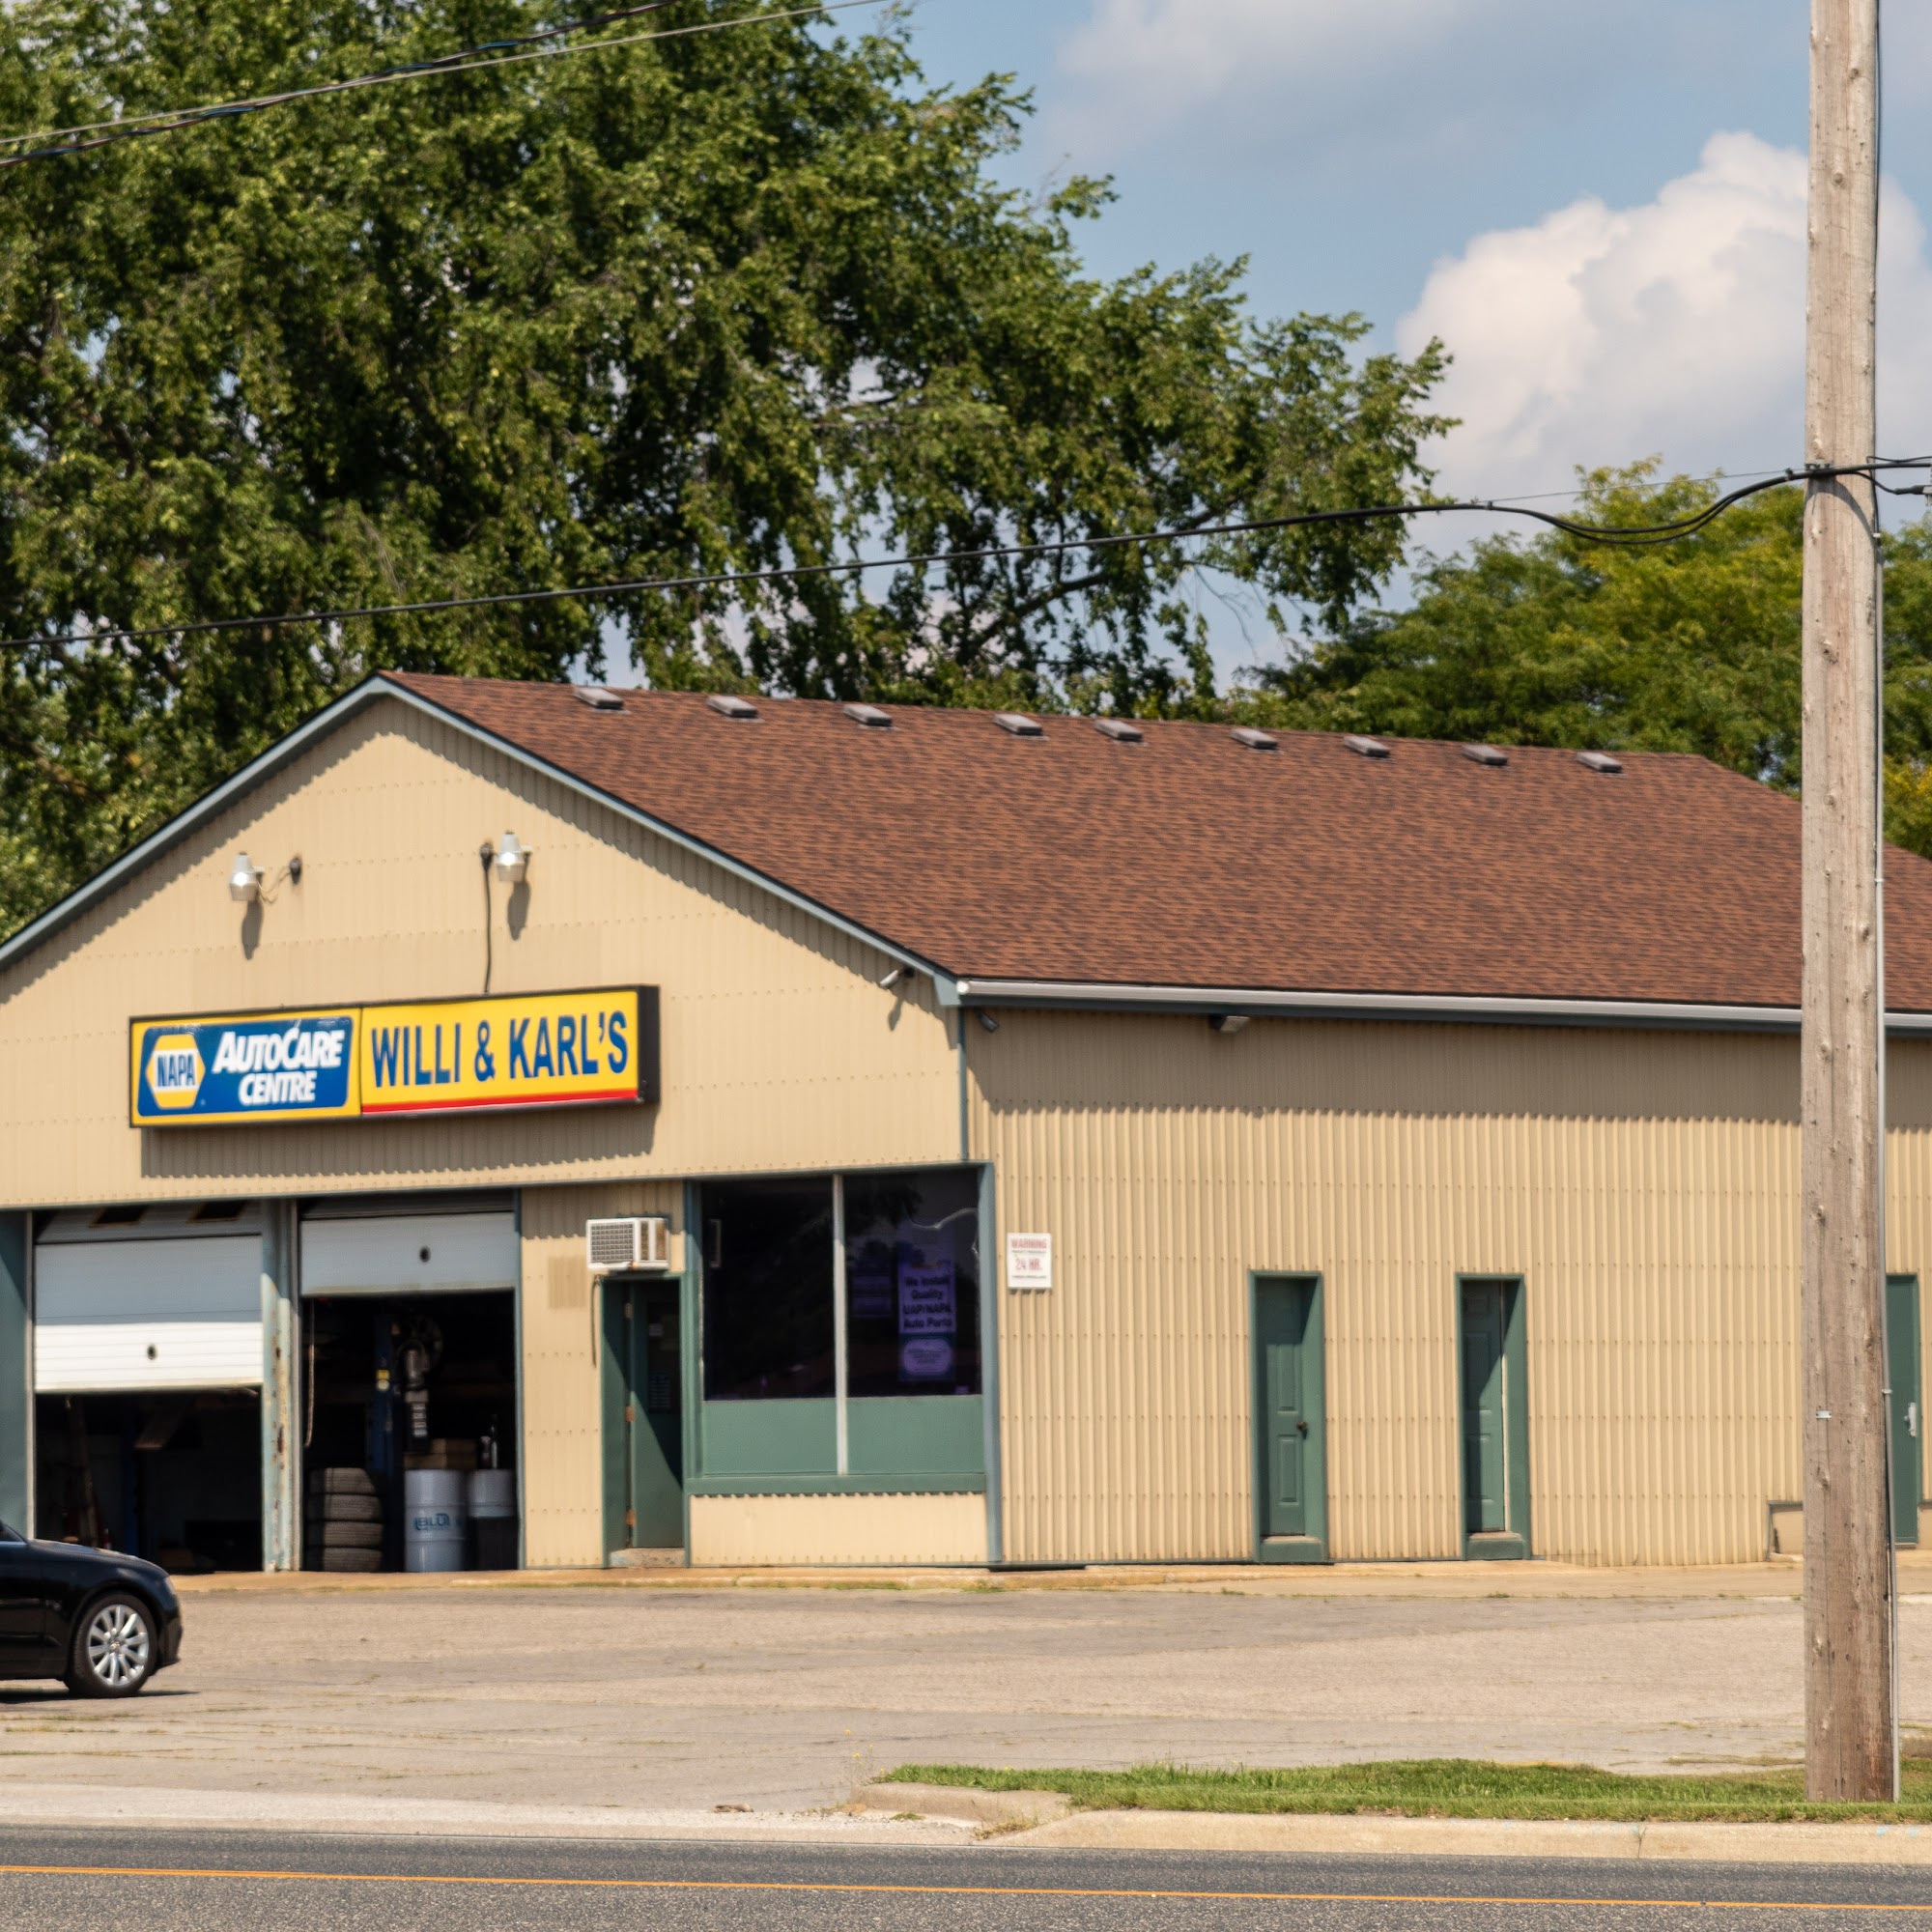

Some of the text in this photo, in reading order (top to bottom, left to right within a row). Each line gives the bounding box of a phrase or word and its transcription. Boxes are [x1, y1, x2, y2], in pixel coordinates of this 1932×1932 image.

[371, 1010, 628, 1088] WILLI & KARL'S
[156, 1054, 195, 1087] NAPA
[238, 1070, 317, 1106] CENTRE
[1011, 1238, 1047, 1249] WARNING
[911, 1289, 943, 1300] Quality
[904, 1318, 924, 1329] Auto
